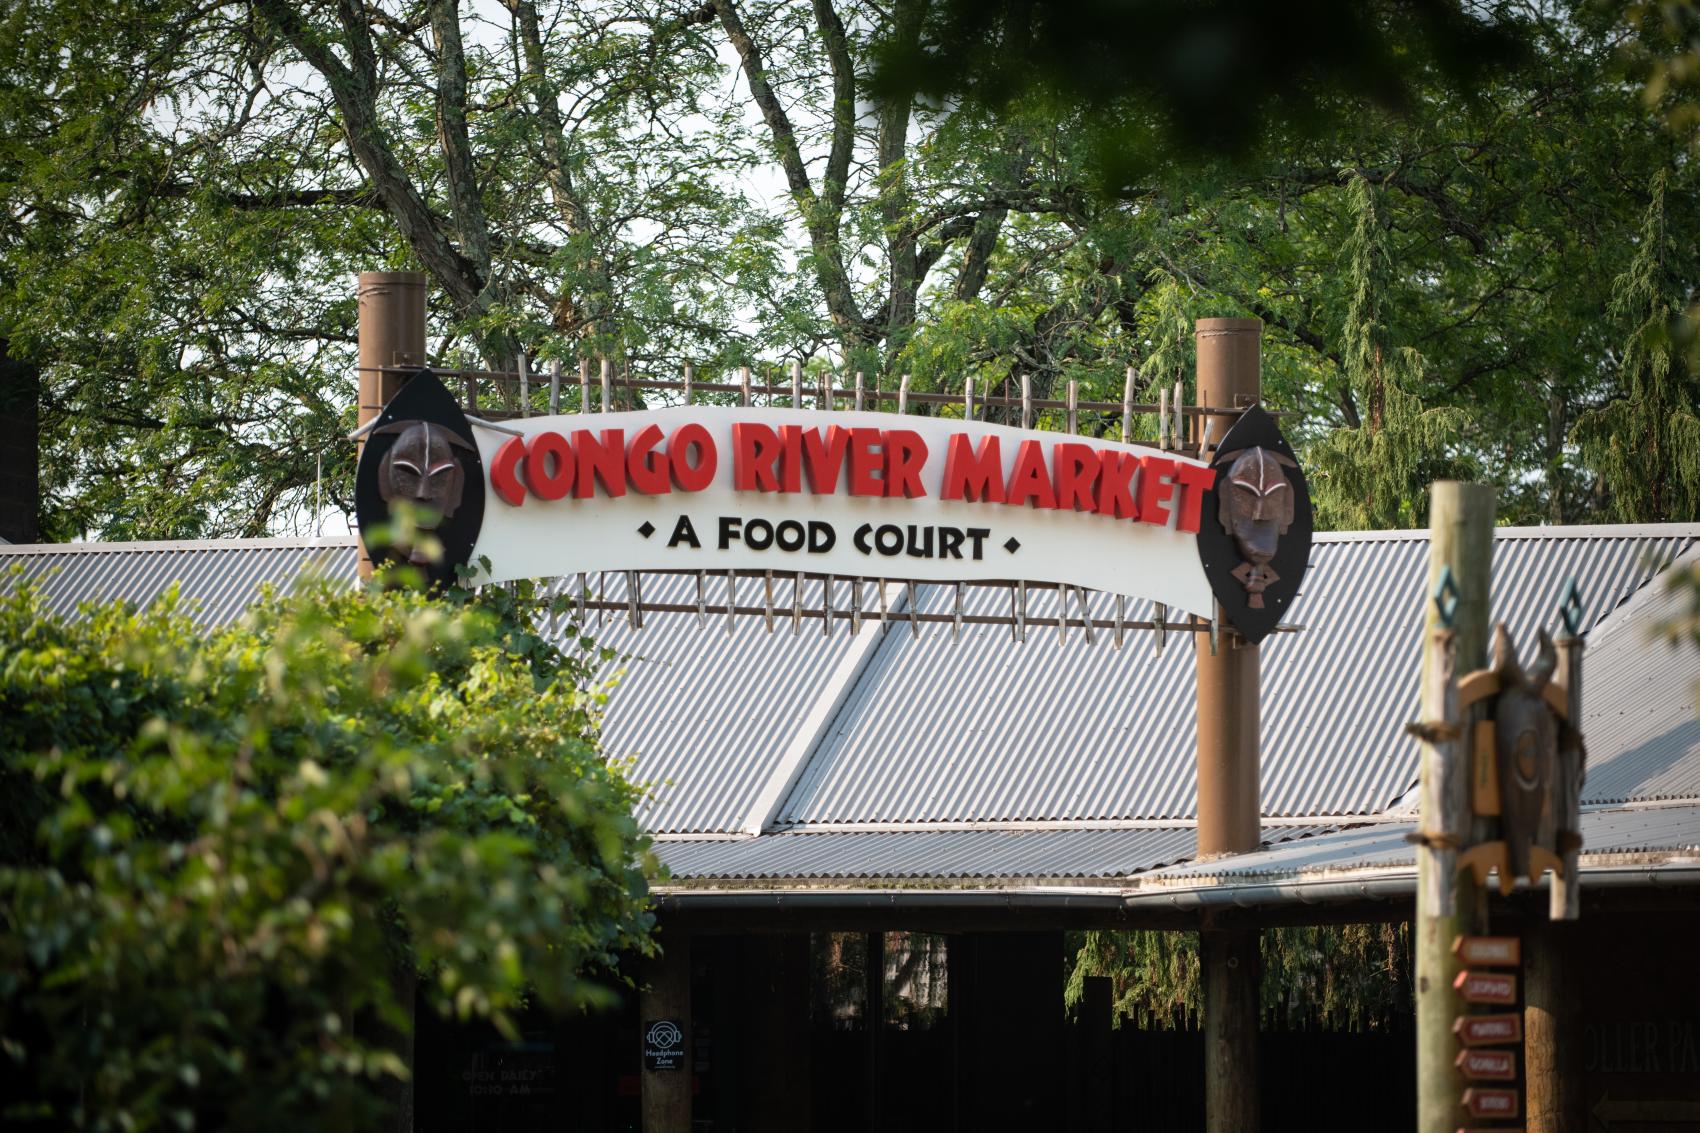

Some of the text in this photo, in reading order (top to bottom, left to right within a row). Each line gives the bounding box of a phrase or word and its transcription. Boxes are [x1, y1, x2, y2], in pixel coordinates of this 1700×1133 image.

[491, 422, 1217, 534] CONGO RIVER MARKET
[668, 513, 991, 561] A FOOD COURT
[645, 1049, 684, 1058] Headphone
[656, 1057, 673, 1065] Zone
